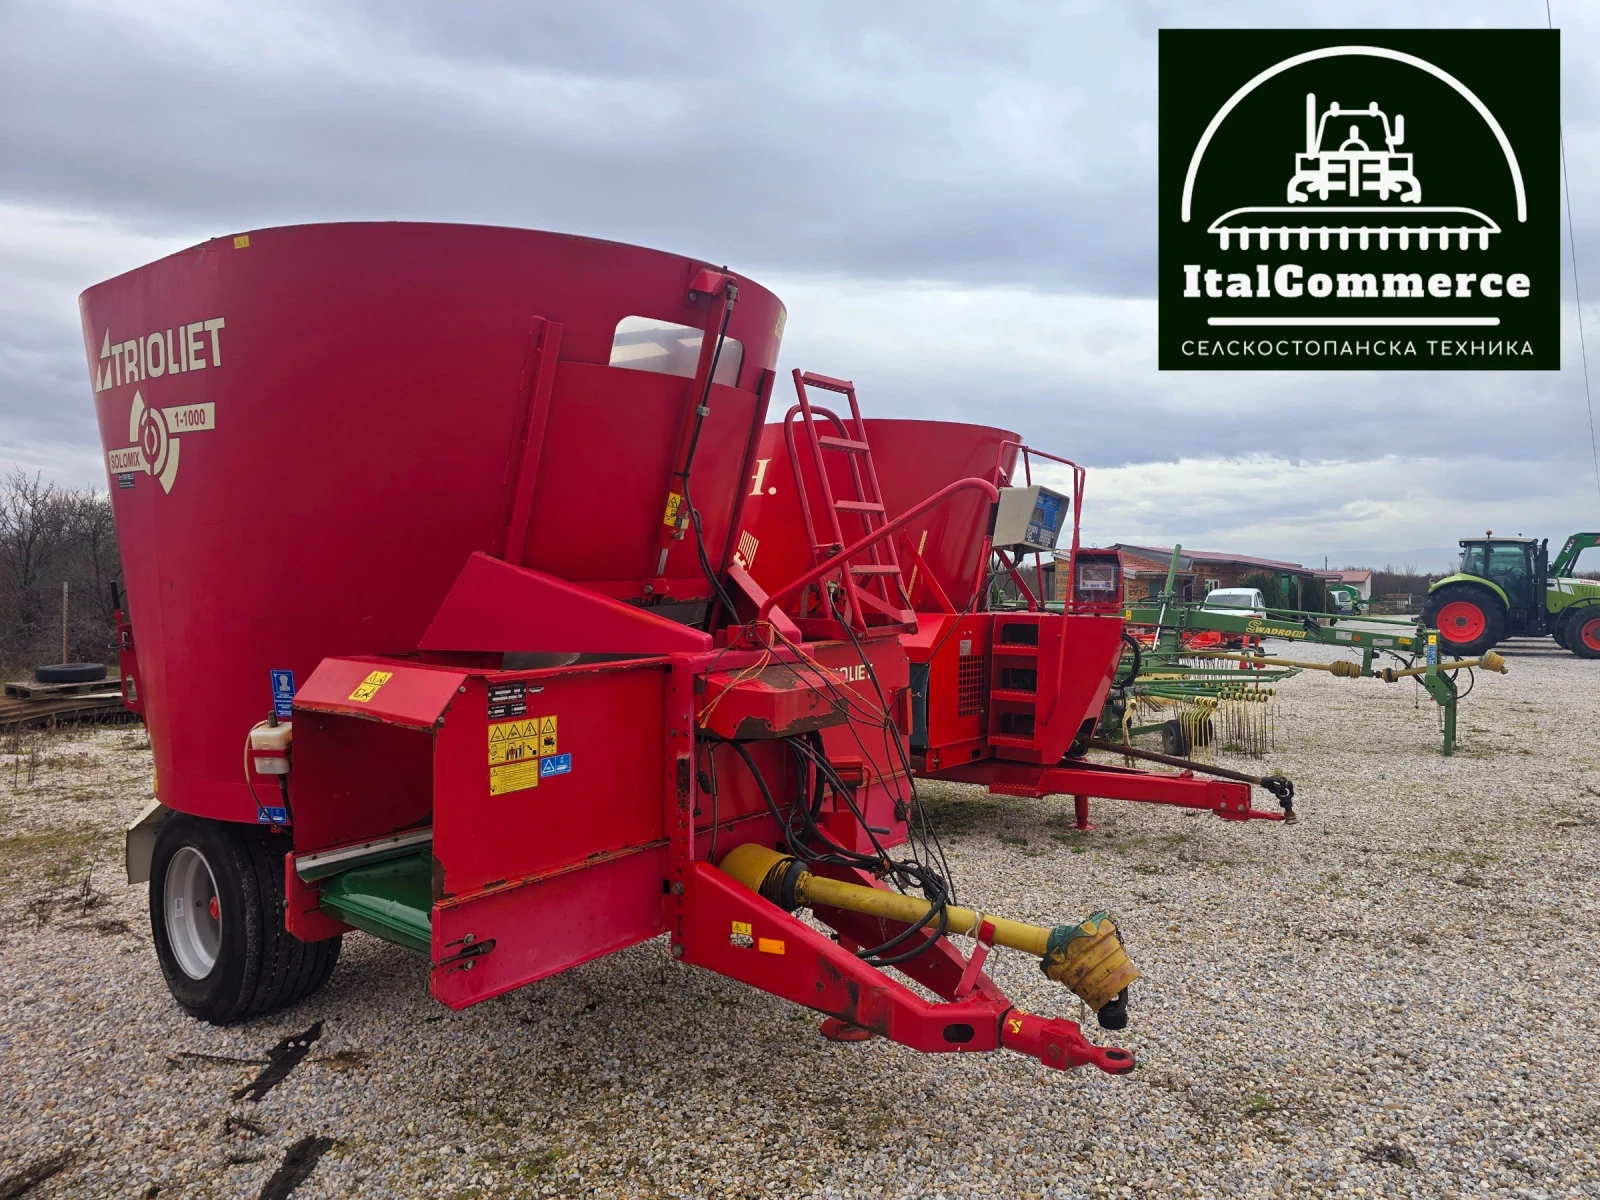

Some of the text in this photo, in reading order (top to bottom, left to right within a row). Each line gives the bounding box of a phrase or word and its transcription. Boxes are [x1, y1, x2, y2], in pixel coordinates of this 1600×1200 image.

[111, 317, 225, 387] TRIOLIET
[174, 408, 205, 427] 1-1000
[111, 451, 140, 469] SOLOMIX
